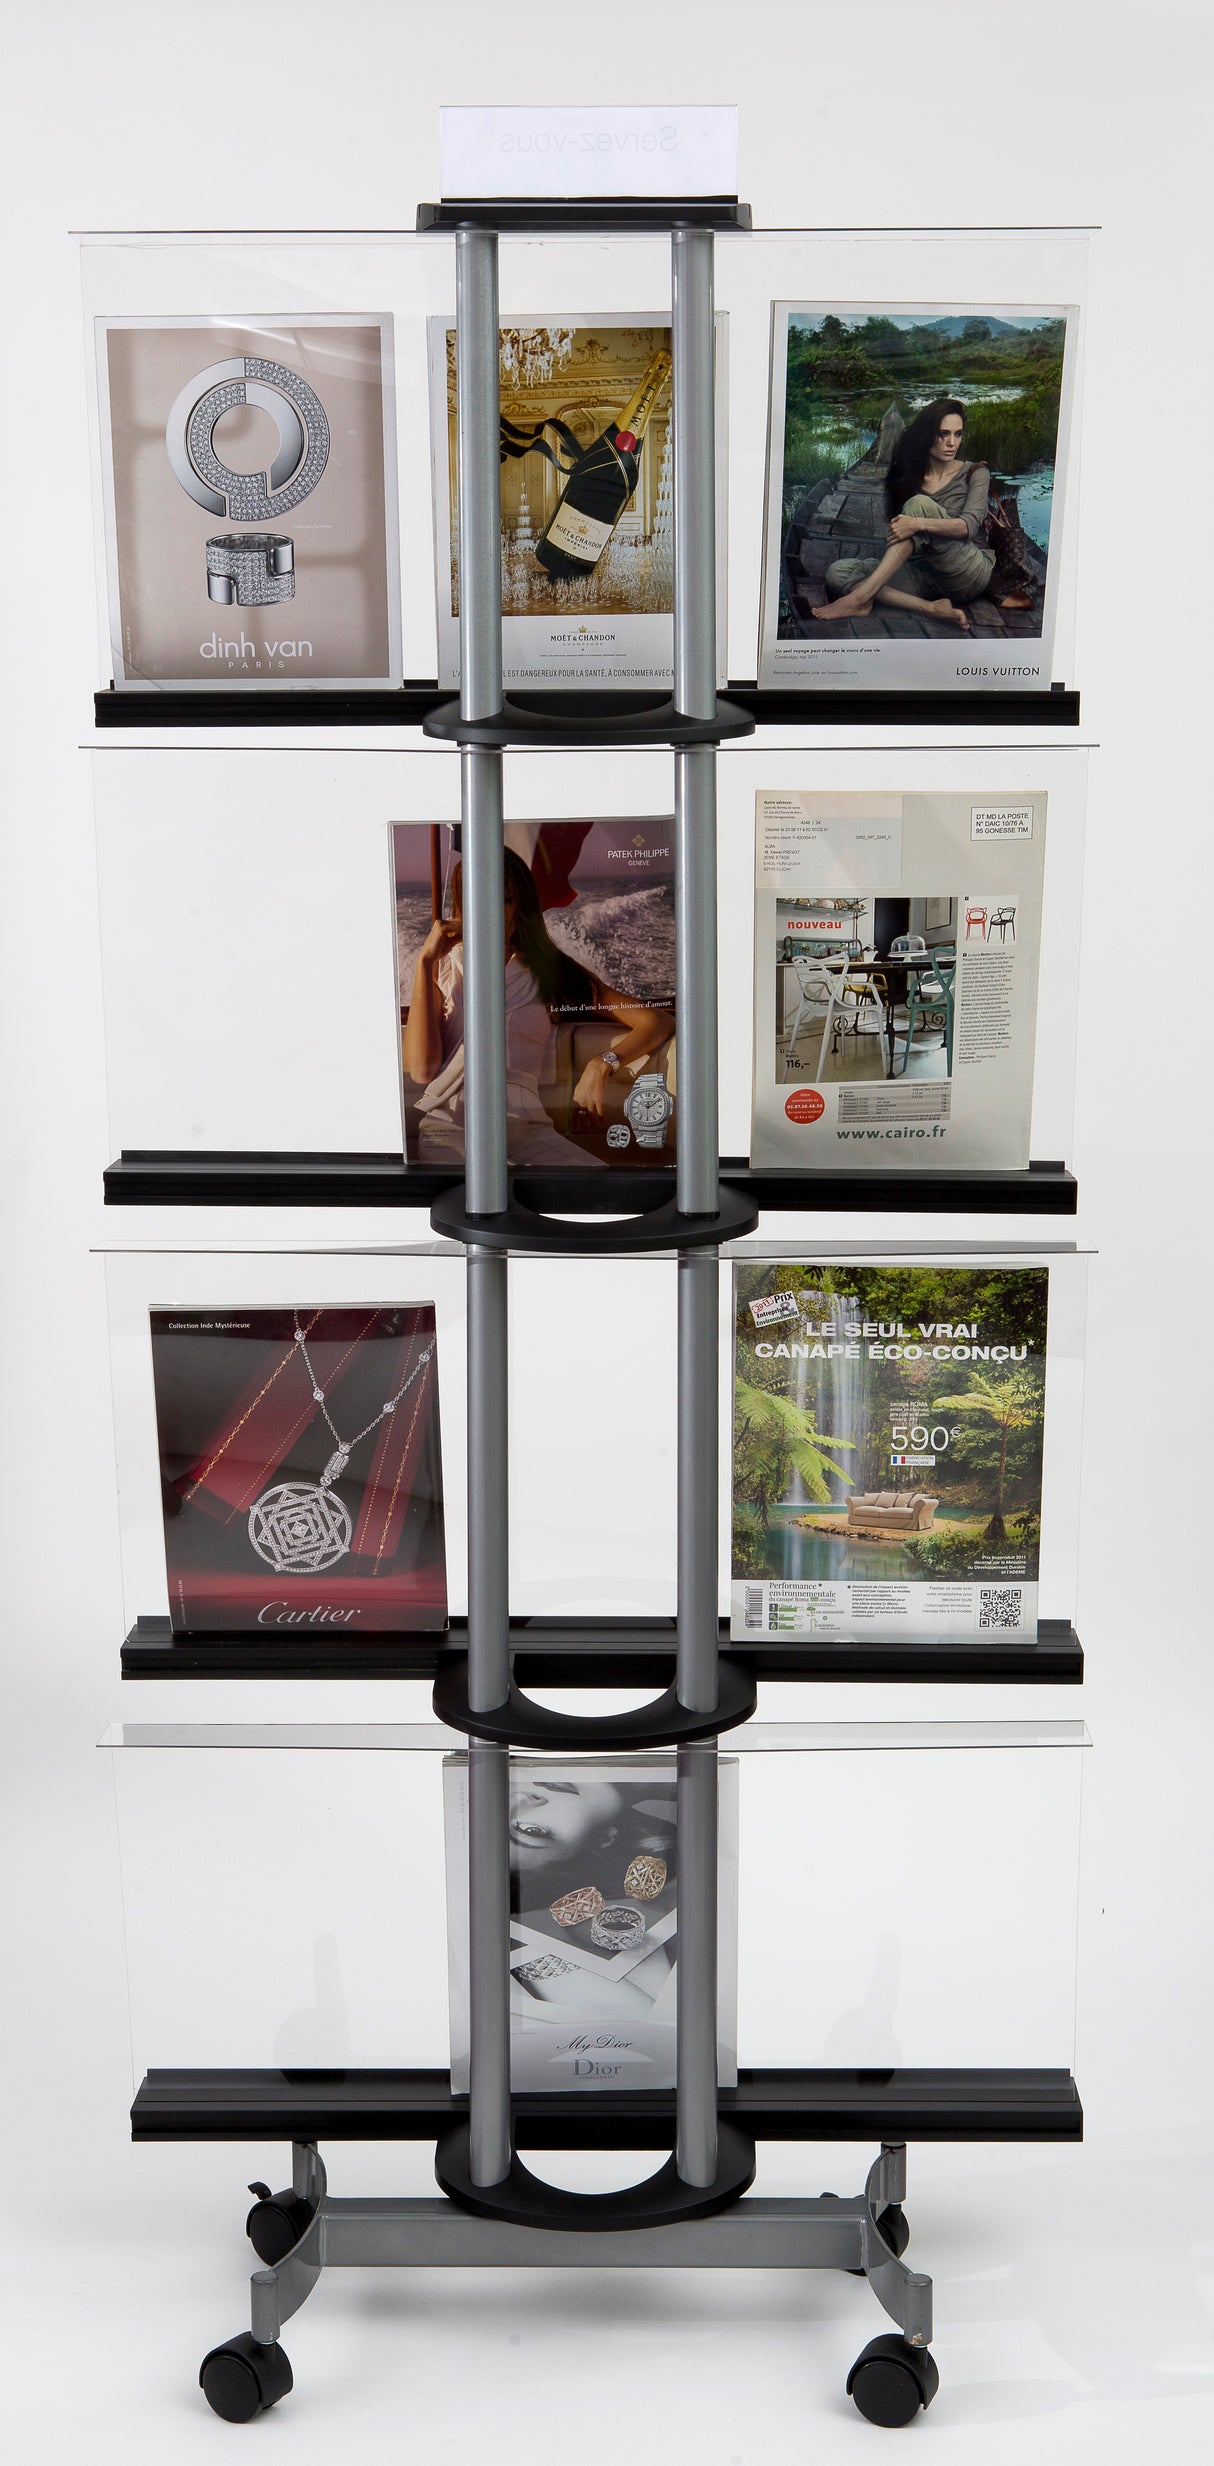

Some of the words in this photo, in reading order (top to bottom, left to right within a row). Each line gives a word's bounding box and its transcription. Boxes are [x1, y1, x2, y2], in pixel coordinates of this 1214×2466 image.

[199, 632, 256, 659] dinh
[264, 640, 313, 657] van
[508, 669, 519, 677] EST
[520, 669, 557, 677] DANGEREUX
[558, 669, 575, 677] POUR
[576, 669, 584, 677] LA
[613, 669, 653, 677] CONSOMMER
[956, 667, 988, 676] LOUIS
[993, 667, 1040, 676] VUITTON
[607, 850, 633, 859] PATEK
[634, 848, 669, 858] PHILIPPE
[787, 919, 842, 930] nouveau
[560, 1004, 578, 1012] début
[579, 1003, 597, 1011] d'une
[598, 1003, 619, 1012] longue
[836, 1125, 946, 1139] www.cairo.fr
[774, 1292, 793, 1303] Prix
[756, 1311, 799, 1326] Environnement
[806, 1323, 836, 1337] LE
[844, 1323, 911, 1338] SEUL
[918, 1323, 978, 1338] VRAI
[754, 1341, 861, 1359] CANAPÉ
[769, 1582, 817, 1590] Performance
[257, 1601, 361, 1624] Cartier
[557, 2034, 593, 2055] My
[594, 2034, 632, 2049] Dior
[573, 2058, 622, 2076] Dior
